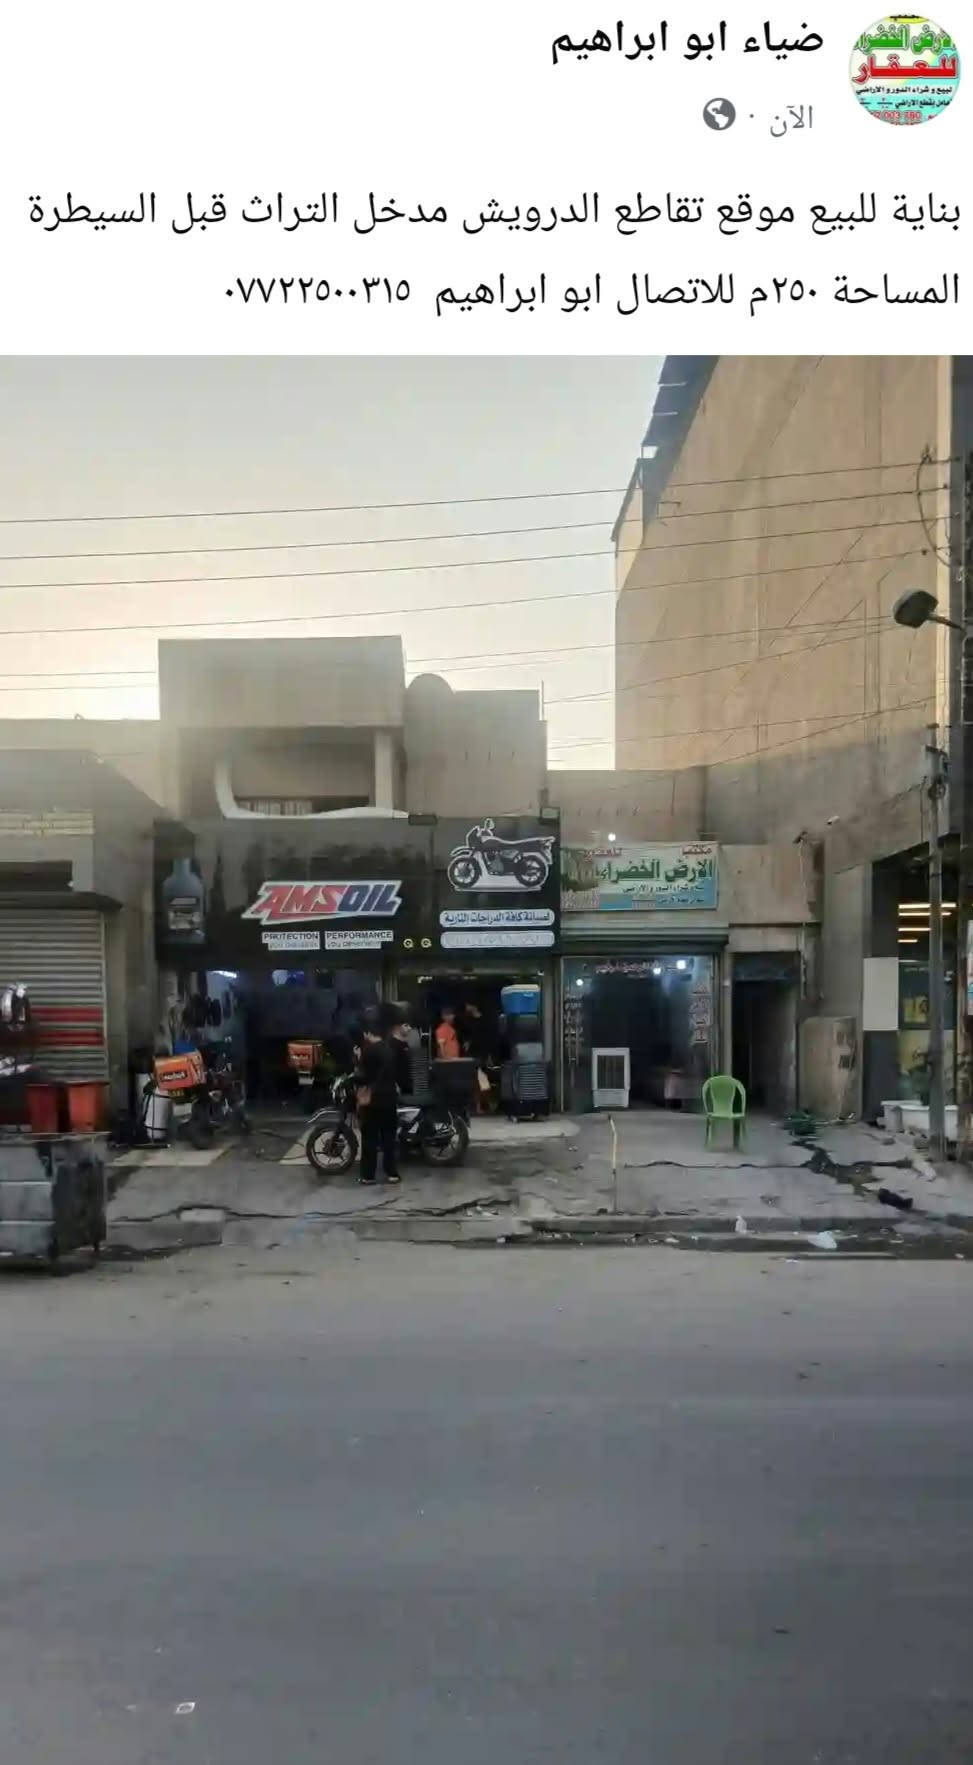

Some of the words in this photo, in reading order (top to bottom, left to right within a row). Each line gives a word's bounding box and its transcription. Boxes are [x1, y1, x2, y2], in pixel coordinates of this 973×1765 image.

[244, 881, 402, 921] AMSOIL
[263, 932, 319, 940] PROTECTION
[326, 931, 393, 939] PERFORMANCE
